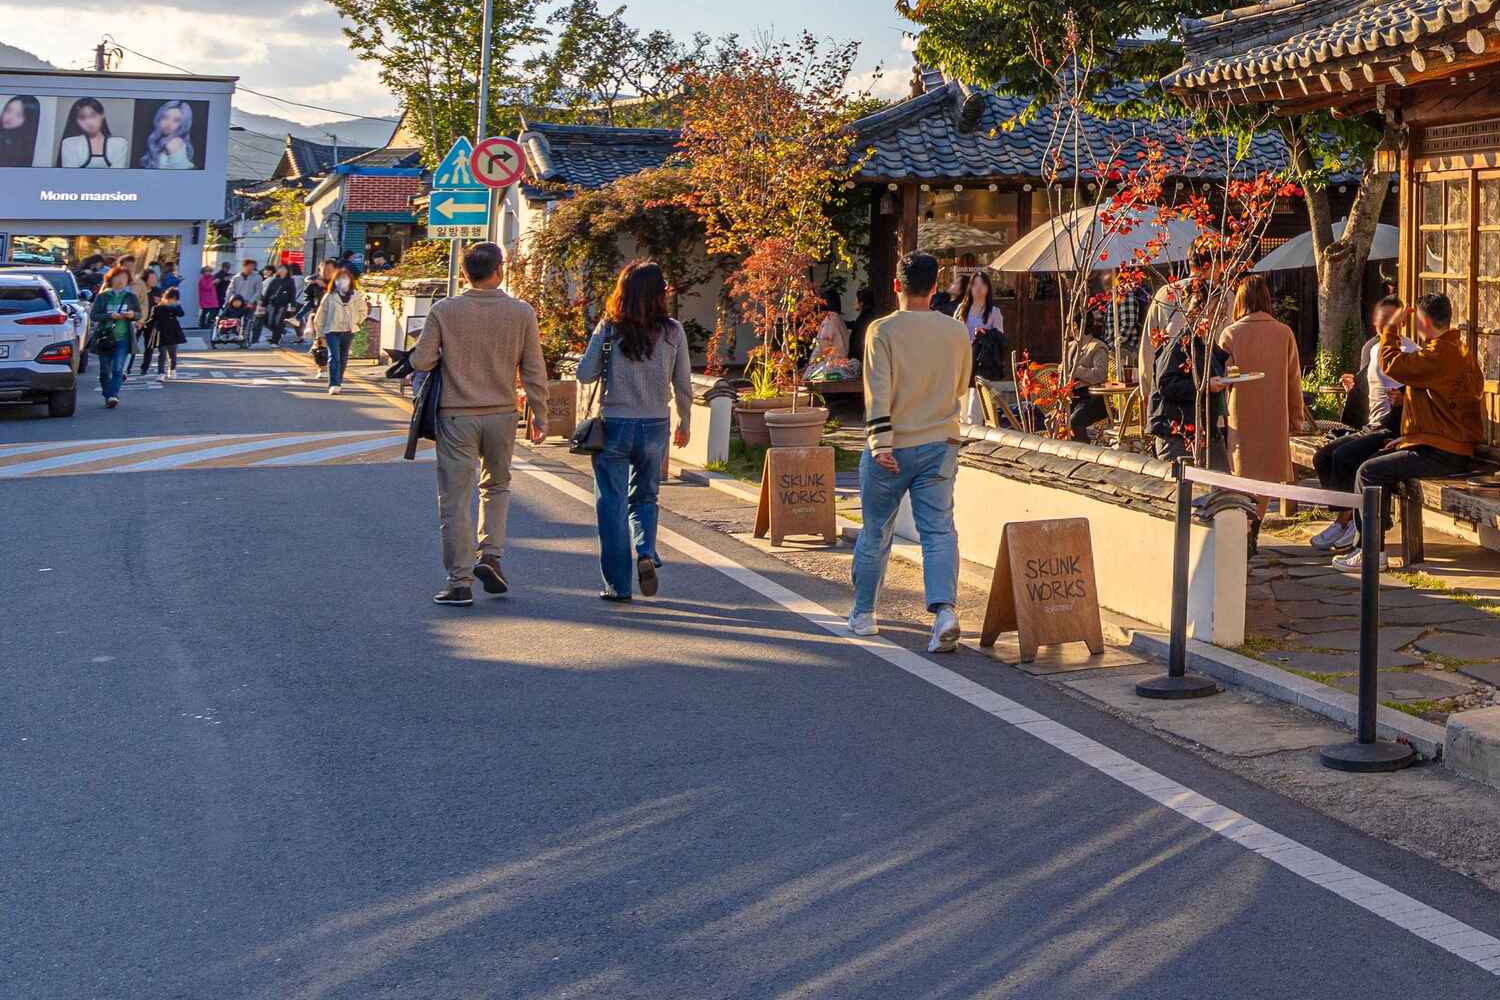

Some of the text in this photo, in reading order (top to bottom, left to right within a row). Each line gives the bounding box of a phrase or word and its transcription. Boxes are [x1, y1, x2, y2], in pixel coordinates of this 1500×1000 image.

[40, 191, 138, 201] Mono mansion
[436, 226, 481, 237] 일방통행
[779, 472, 825, 489] SKUNK
[779, 489, 827, 505] WORKS
[1024, 555, 1082, 580] SKUNK
[1025, 579, 1087, 601] WORKS
